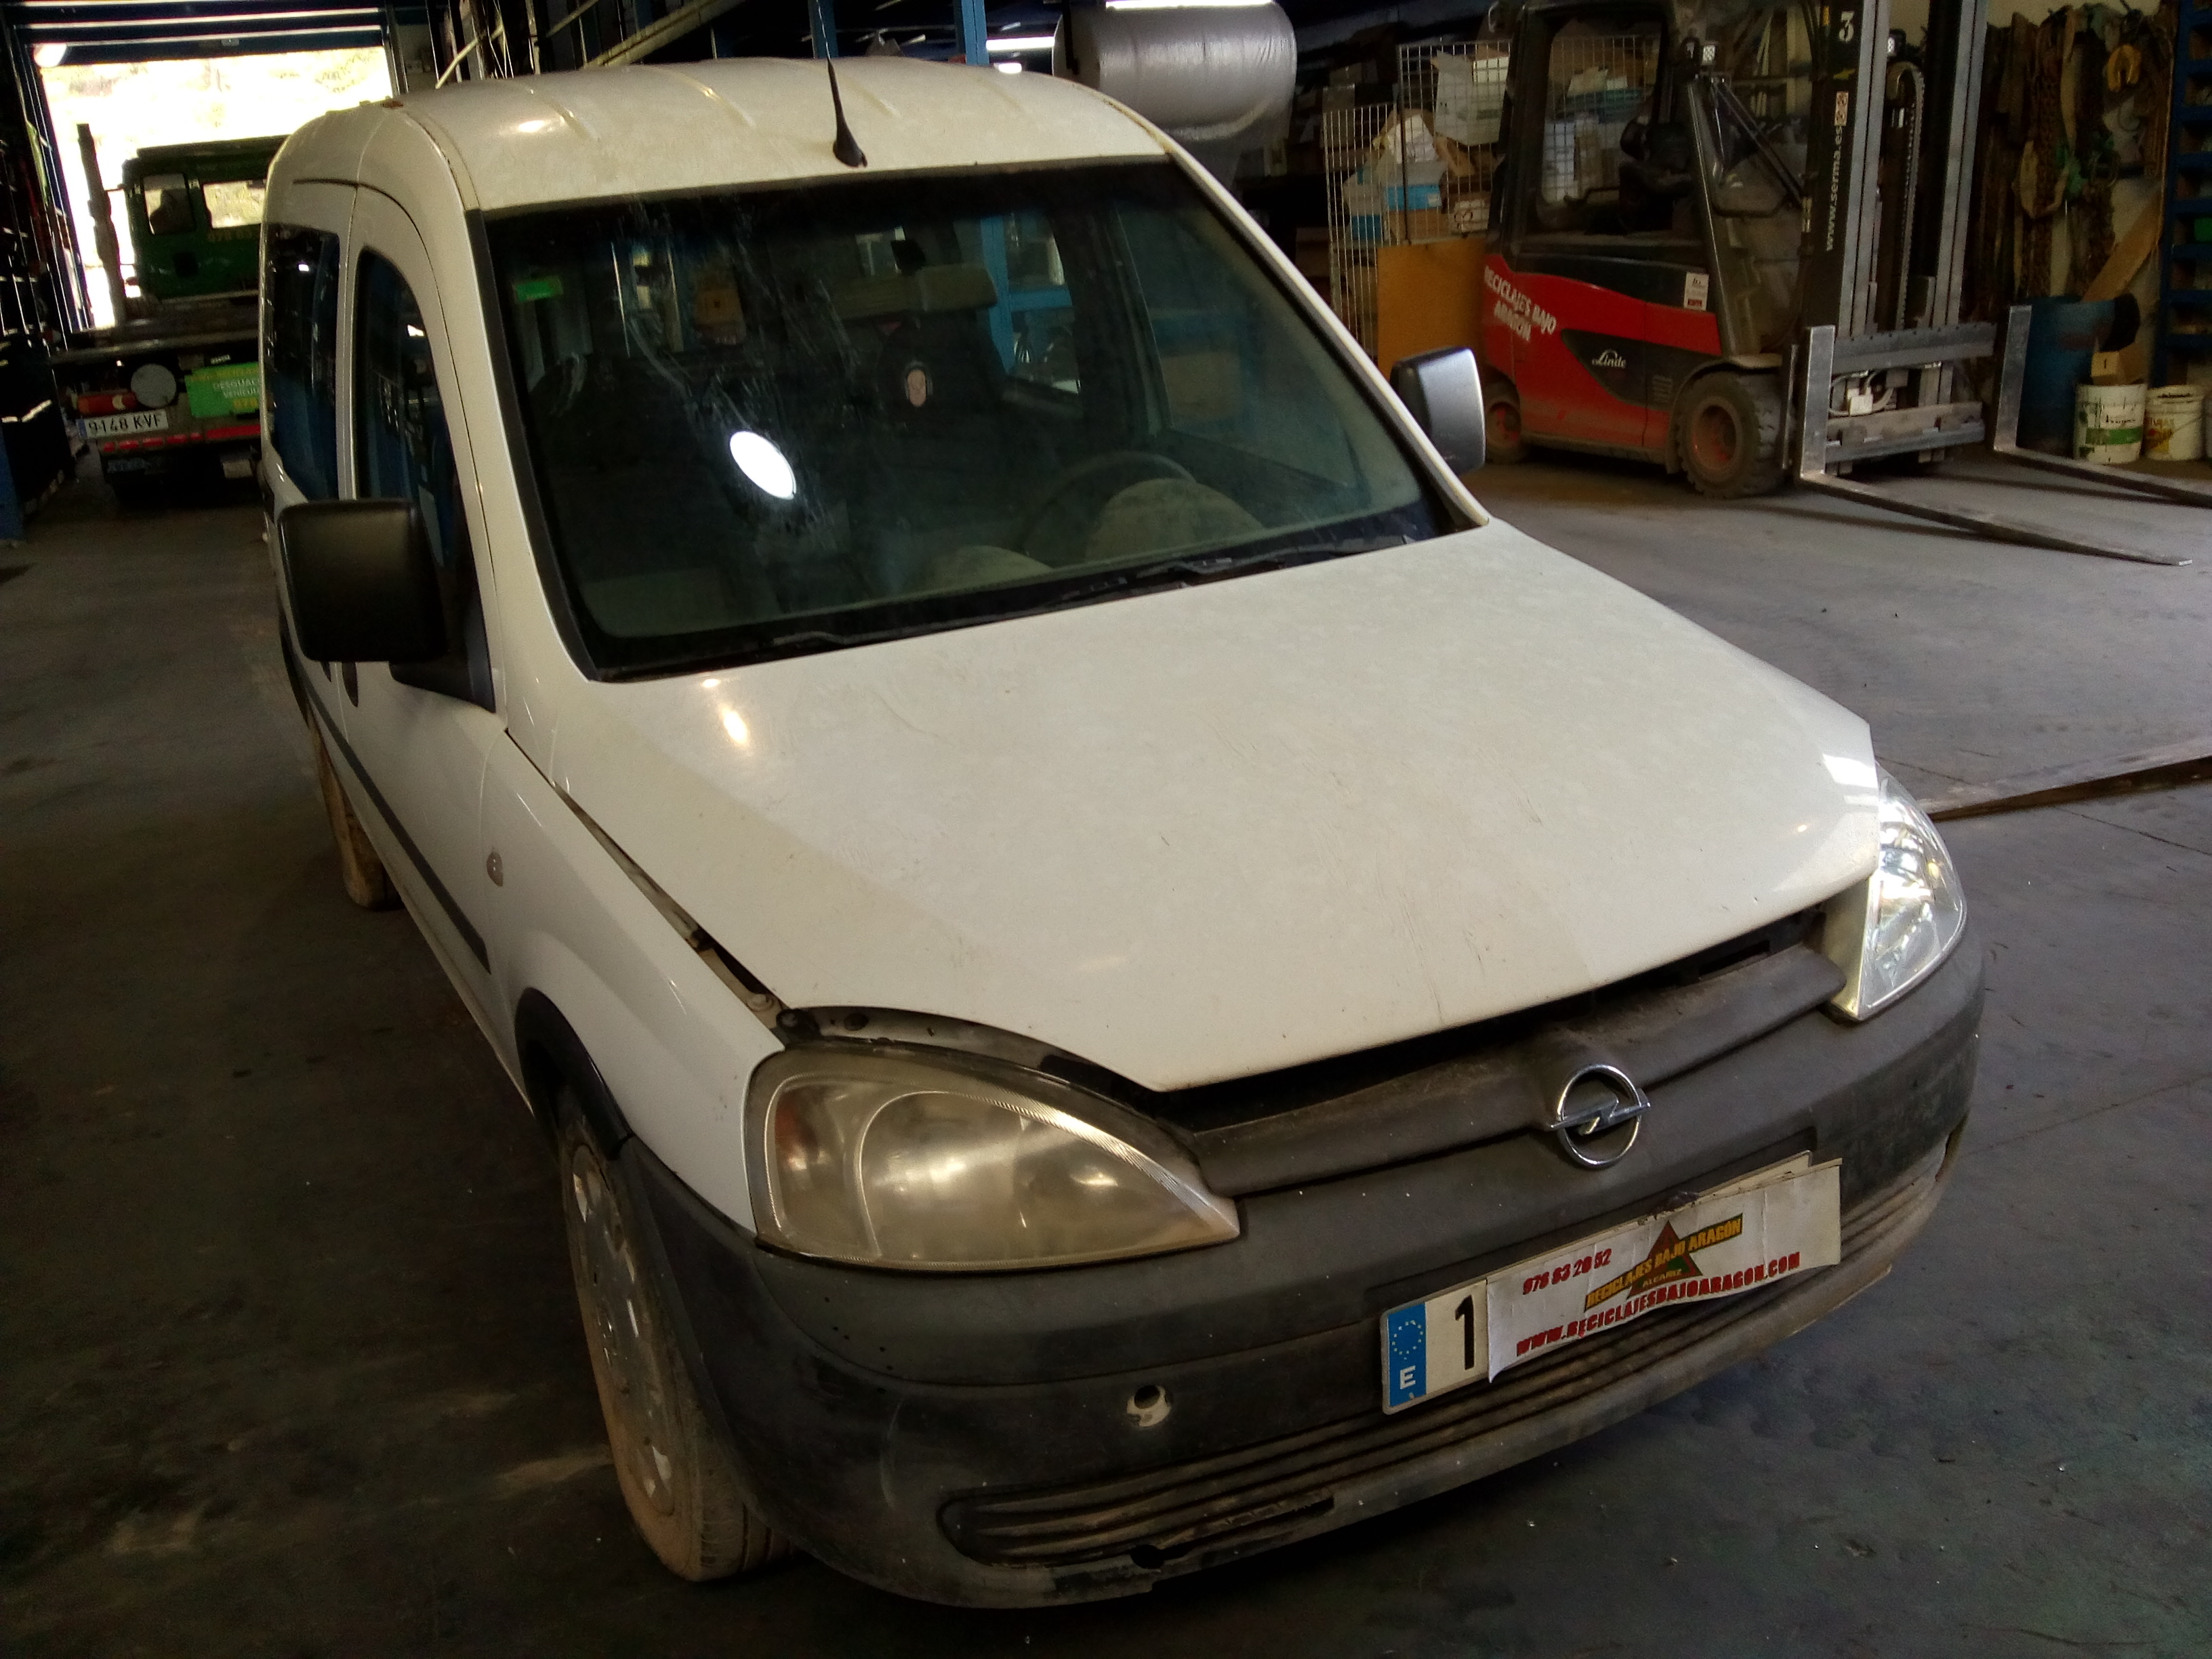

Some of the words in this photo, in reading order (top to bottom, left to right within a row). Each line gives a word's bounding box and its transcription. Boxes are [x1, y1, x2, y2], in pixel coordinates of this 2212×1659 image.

[1572, 1256, 1593, 1277] 20
[1594, 1248, 1612, 1269] 52
[1586, 1258, 1653, 1309] RECICLAJES
[1655, 1240, 1685, 1268] BAJO
[1516, 1252, 1801, 1356] WWW.RECICLAJESBAJOARAGON.COM
[1399, 1365, 1416, 1390] E
